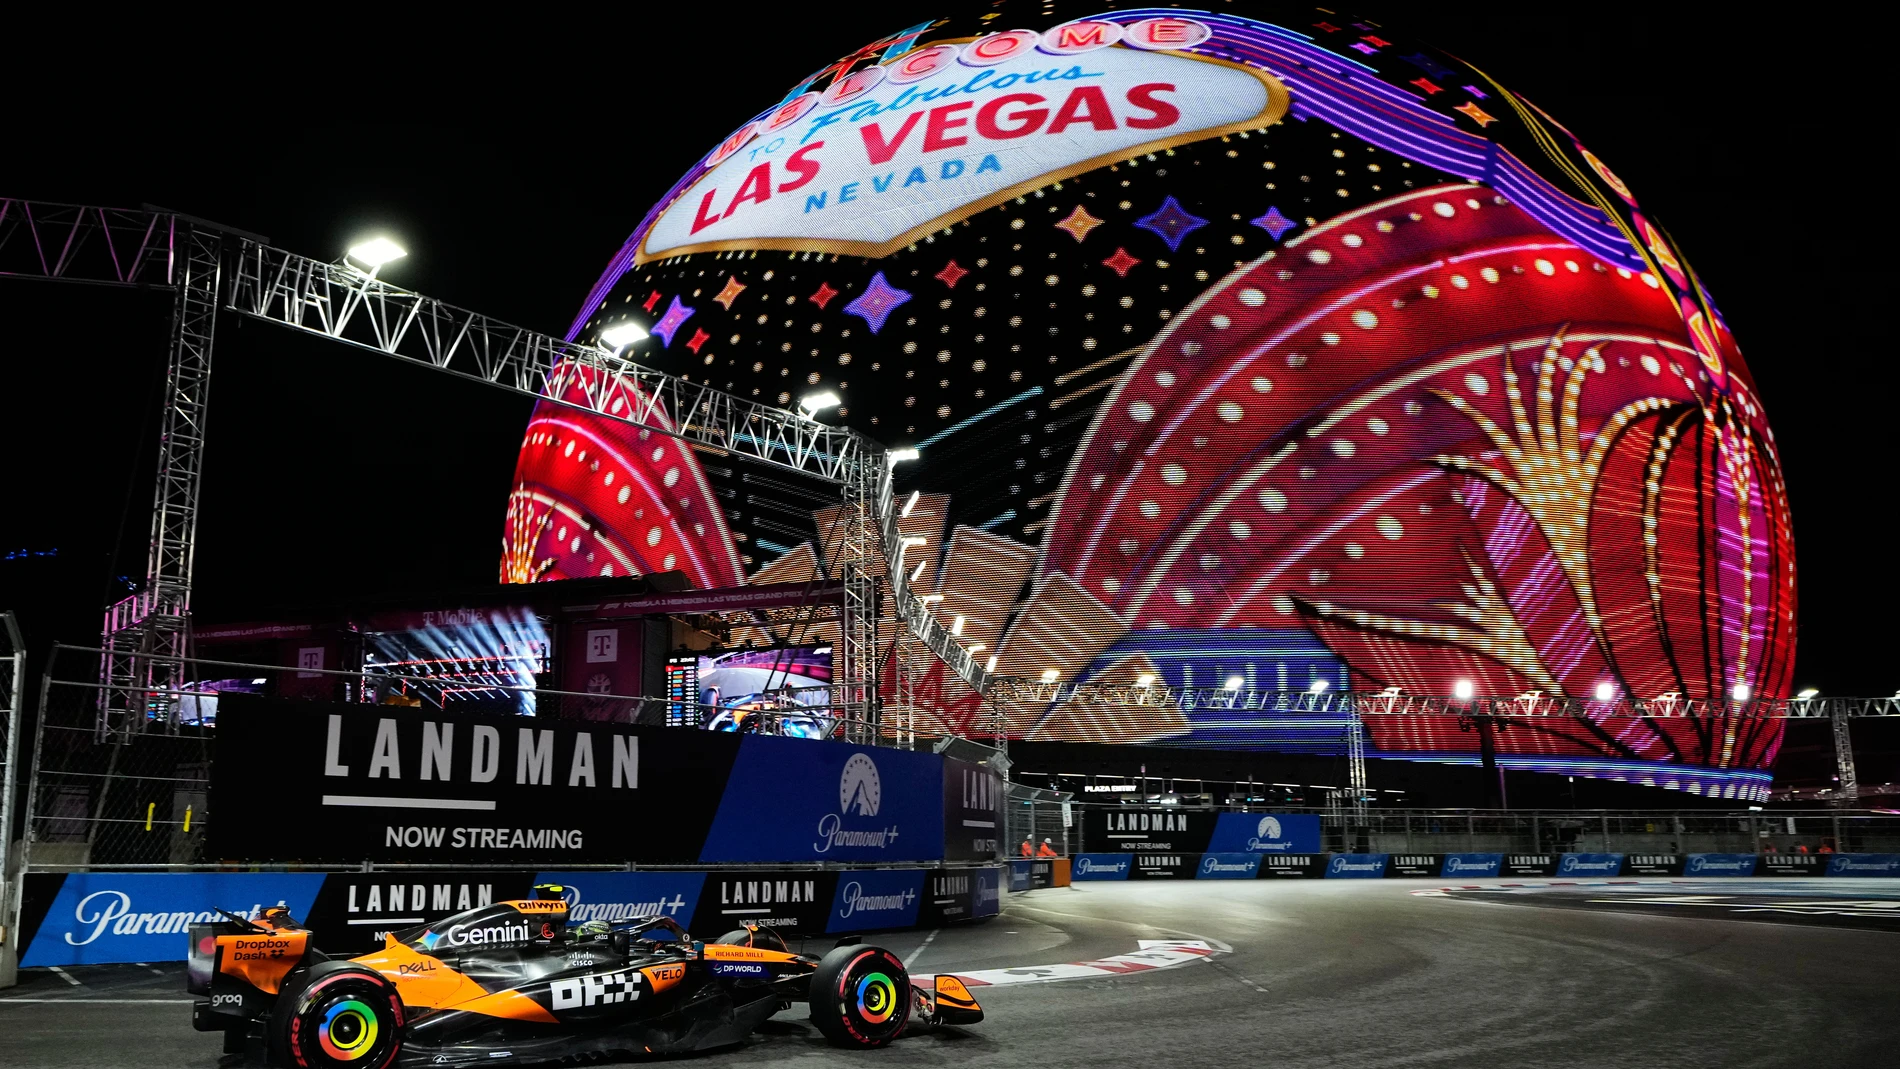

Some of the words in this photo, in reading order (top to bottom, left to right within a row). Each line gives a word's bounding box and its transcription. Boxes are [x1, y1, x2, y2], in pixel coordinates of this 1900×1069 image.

[713, 22, 1187, 159] WELCOME
[748, 137, 784, 163] TO
[800, 63, 1105, 143] Fabulous
[689, 140, 825, 236] LAS
[860, 82, 1181, 166] VEGAS
[803, 153, 1002, 214] NEVADA
[708, 596, 724, 604] LAS
[725, 594, 753, 602] VEGAS
[754, 592, 782, 600] GRAND
[783, 590, 803, 598] PRIX
[594, 635, 610, 656] T
[324, 714, 639, 789] LANDMAN
[1107, 813, 1187, 832] LANDMAN
[385, 826, 446, 849] NOW
[450, 827, 583, 850] STREAMING
[1136, 842, 1172, 850] STREAMING
[1139, 856, 1181, 867] LANDMAN
[1268, 856, 1311, 866] LANDMAN
[1394, 855, 1435, 866] LANDMAN
[1508, 855, 1550, 865] LANDMAN
[1630, 855, 1676, 865] LANDMAN
[348, 884, 492, 912] LANDMAN
[721, 880, 815, 904] LANDMAN
[518, 900, 564, 910] allwyn
[739, 919, 757, 927] NOW
[758, 917, 798, 927] STREAMING
[448, 919, 529, 946] Gemini
[235, 939, 290, 951] Dropbox
[234, 950, 266, 961] Dash
[399, 960, 437, 975] DELL
[652, 968, 682, 981] VELO
[723, 965, 734, 973] DP
[735, 965, 762, 973] WORLD
[212, 993, 243, 1007] groq
